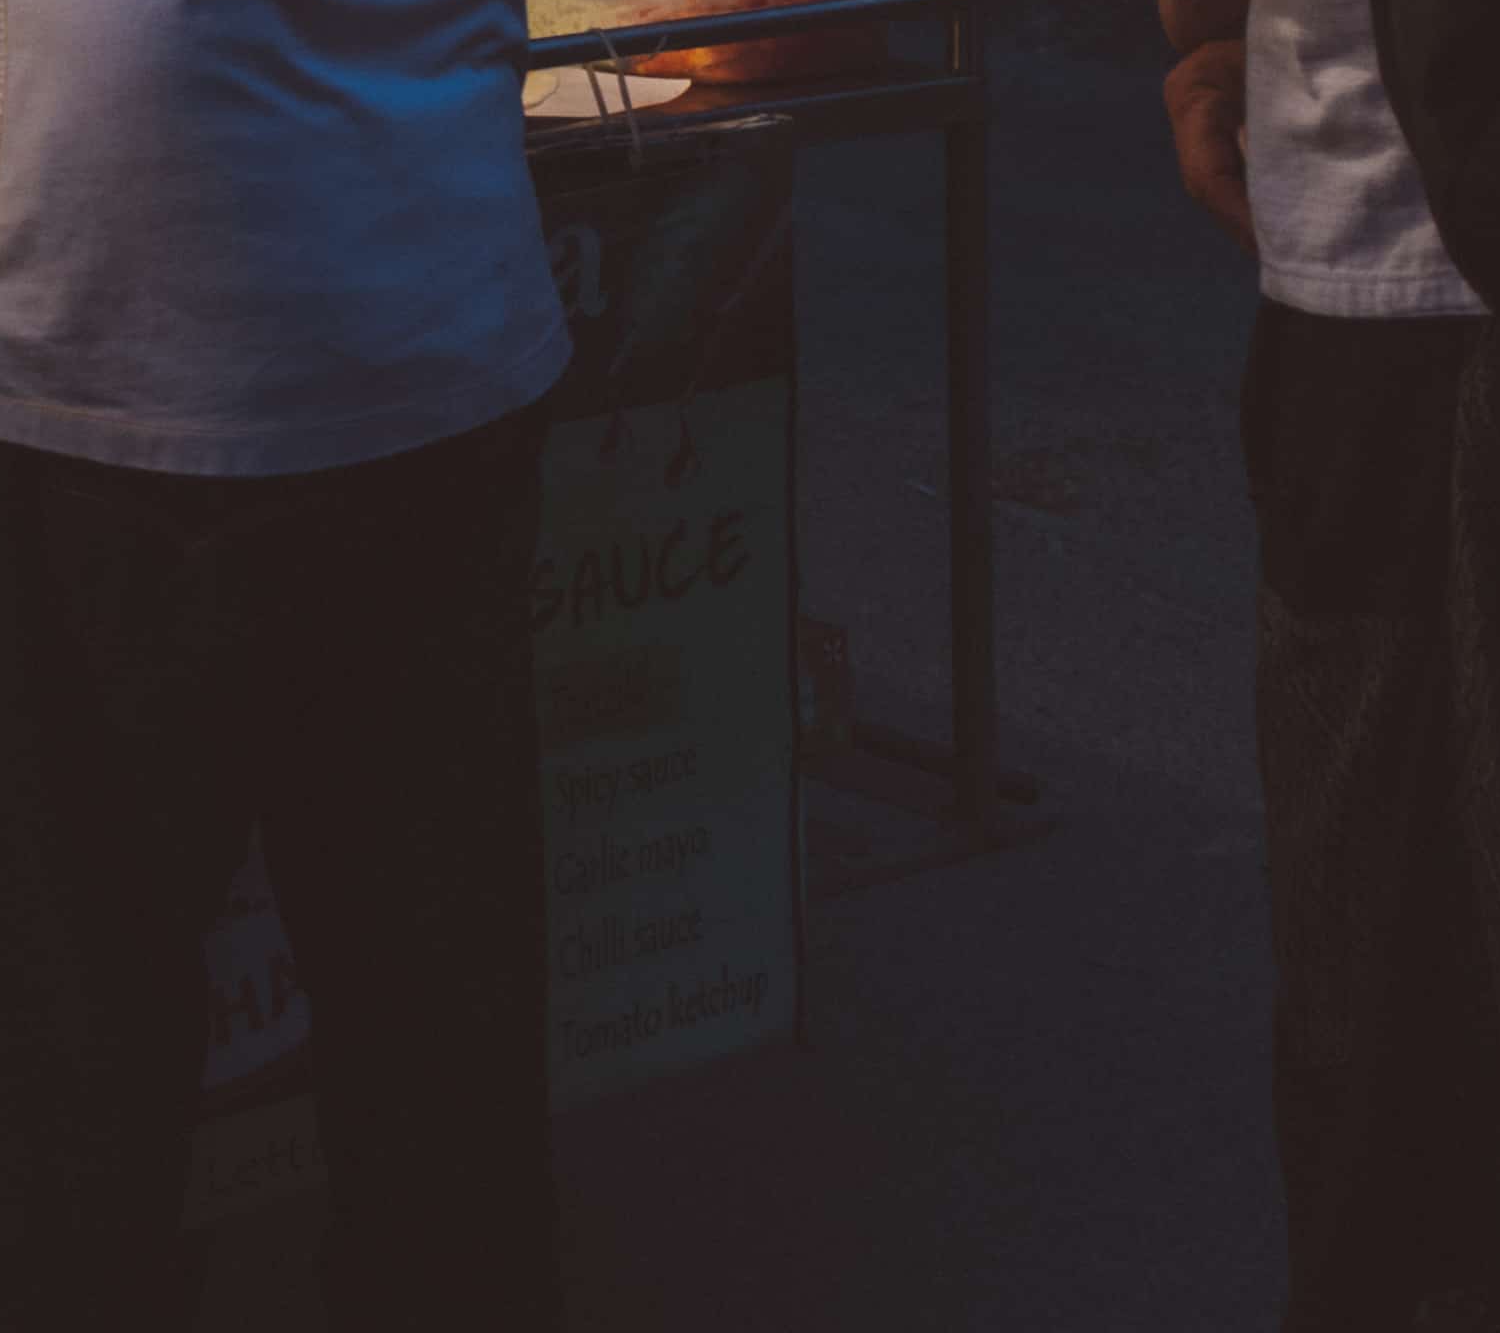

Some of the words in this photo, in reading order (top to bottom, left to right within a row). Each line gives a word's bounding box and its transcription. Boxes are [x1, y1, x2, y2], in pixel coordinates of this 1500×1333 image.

[531, 509, 753, 635] SAUCE
[552, 764, 623, 824] Spicy
[628, 749, 698, 794] sauce
[633, 908, 704, 957] sauce
